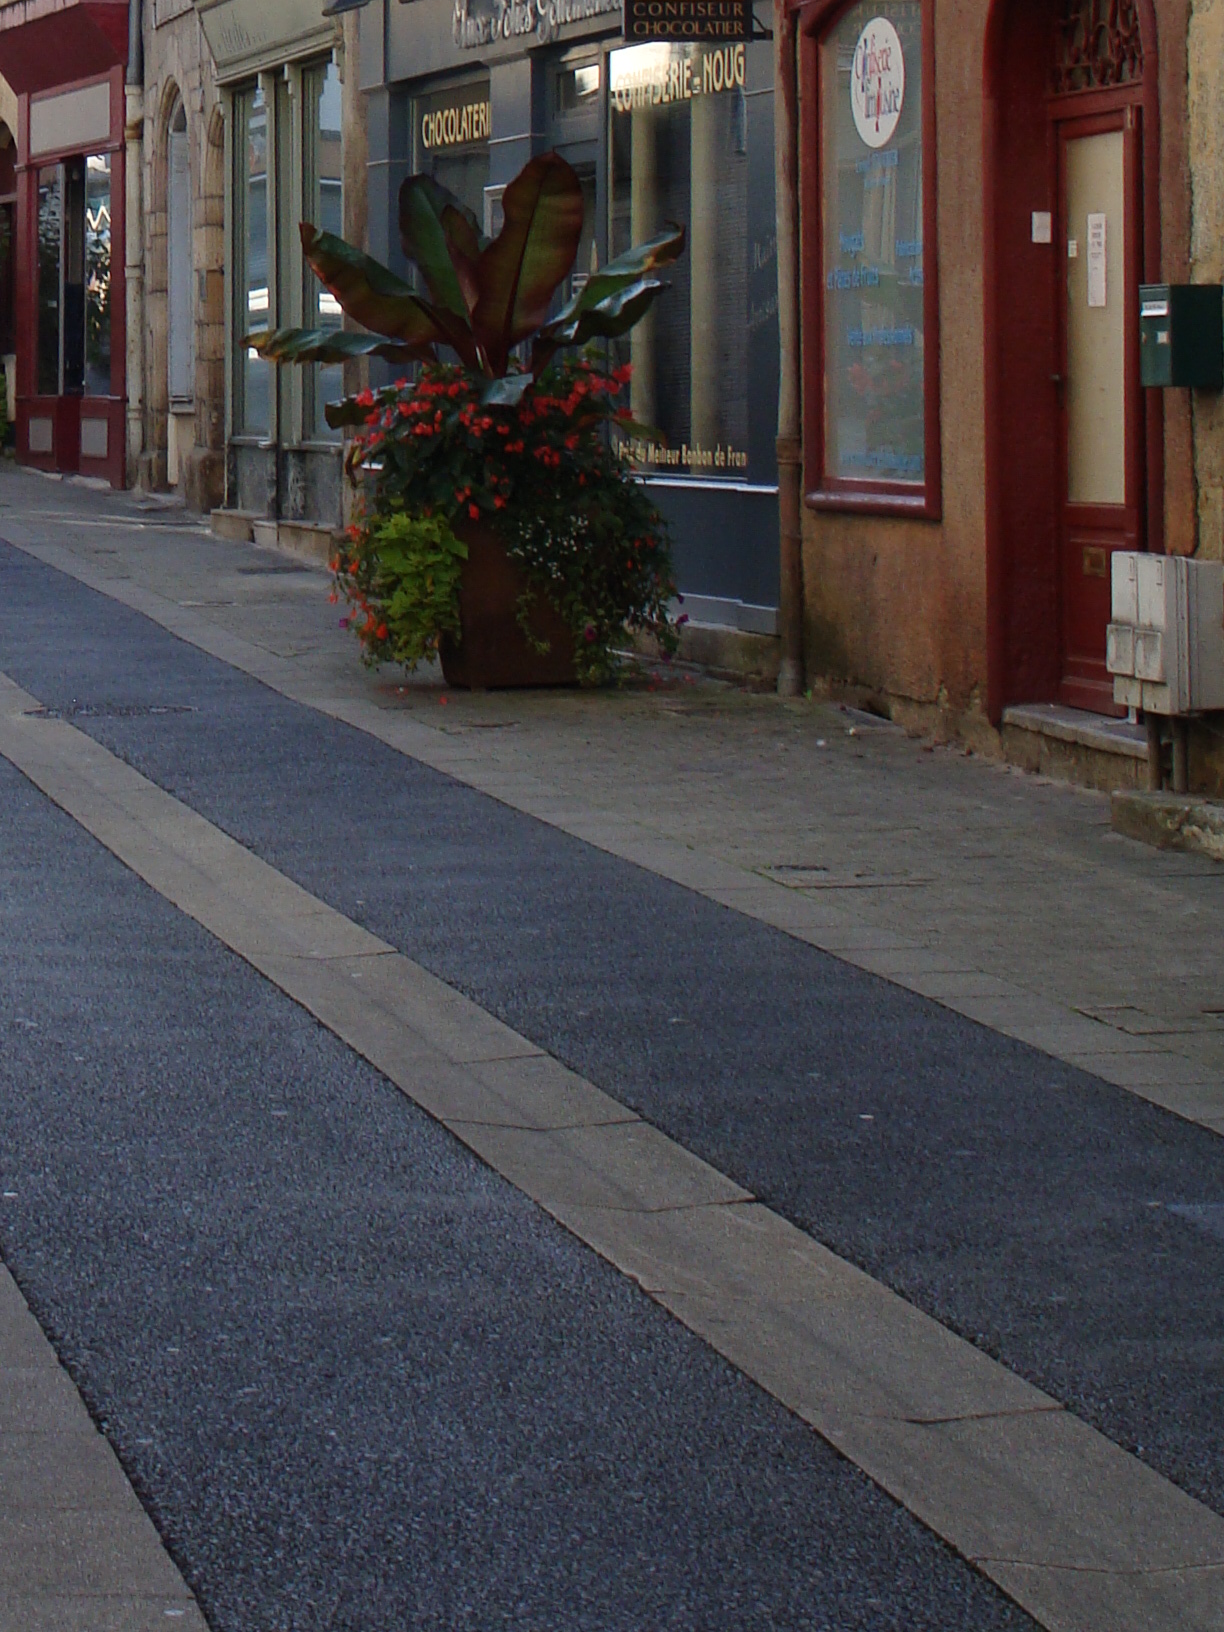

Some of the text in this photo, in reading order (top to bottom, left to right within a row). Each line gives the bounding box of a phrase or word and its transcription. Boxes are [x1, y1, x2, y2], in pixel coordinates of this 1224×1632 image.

[633, 2, 744, 16] CONFISEUR
[633, 20, 744, 35] CHOCOLATIER
[682, 443, 713, 466] Bonbon
[715, 443, 725, 467] de
